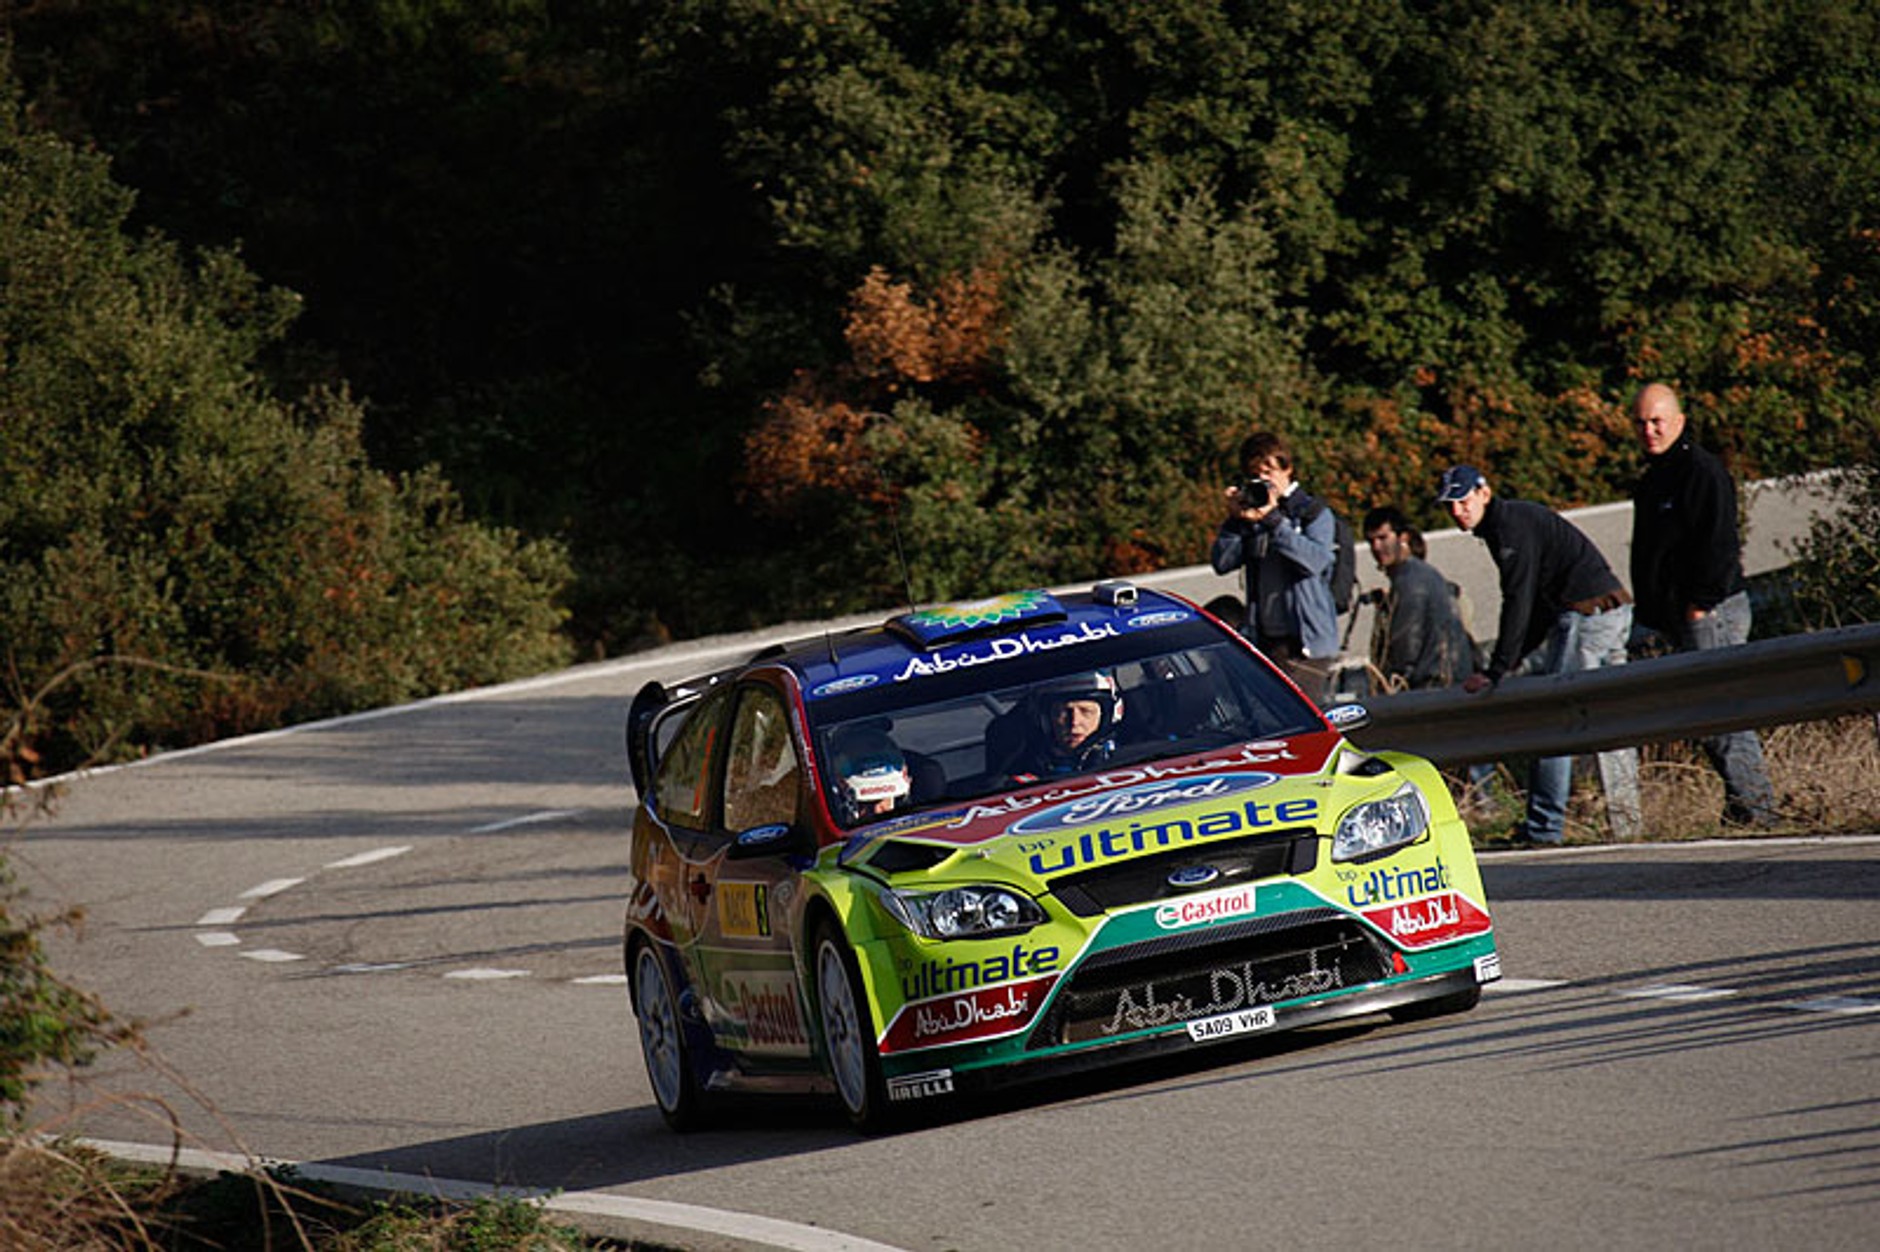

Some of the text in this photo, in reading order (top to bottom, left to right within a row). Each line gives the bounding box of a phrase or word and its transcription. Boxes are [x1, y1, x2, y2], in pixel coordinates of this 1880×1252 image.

[1062, 777, 1230, 828] Ford
[1018, 838, 1055, 854] bp
[1029, 798, 1319, 876] ultimate
[1181, 891, 1250, 924] Castrol
[903, 944, 1059, 1000] ultimate
[1193, 1011, 1269, 1038] SA09 VHR
